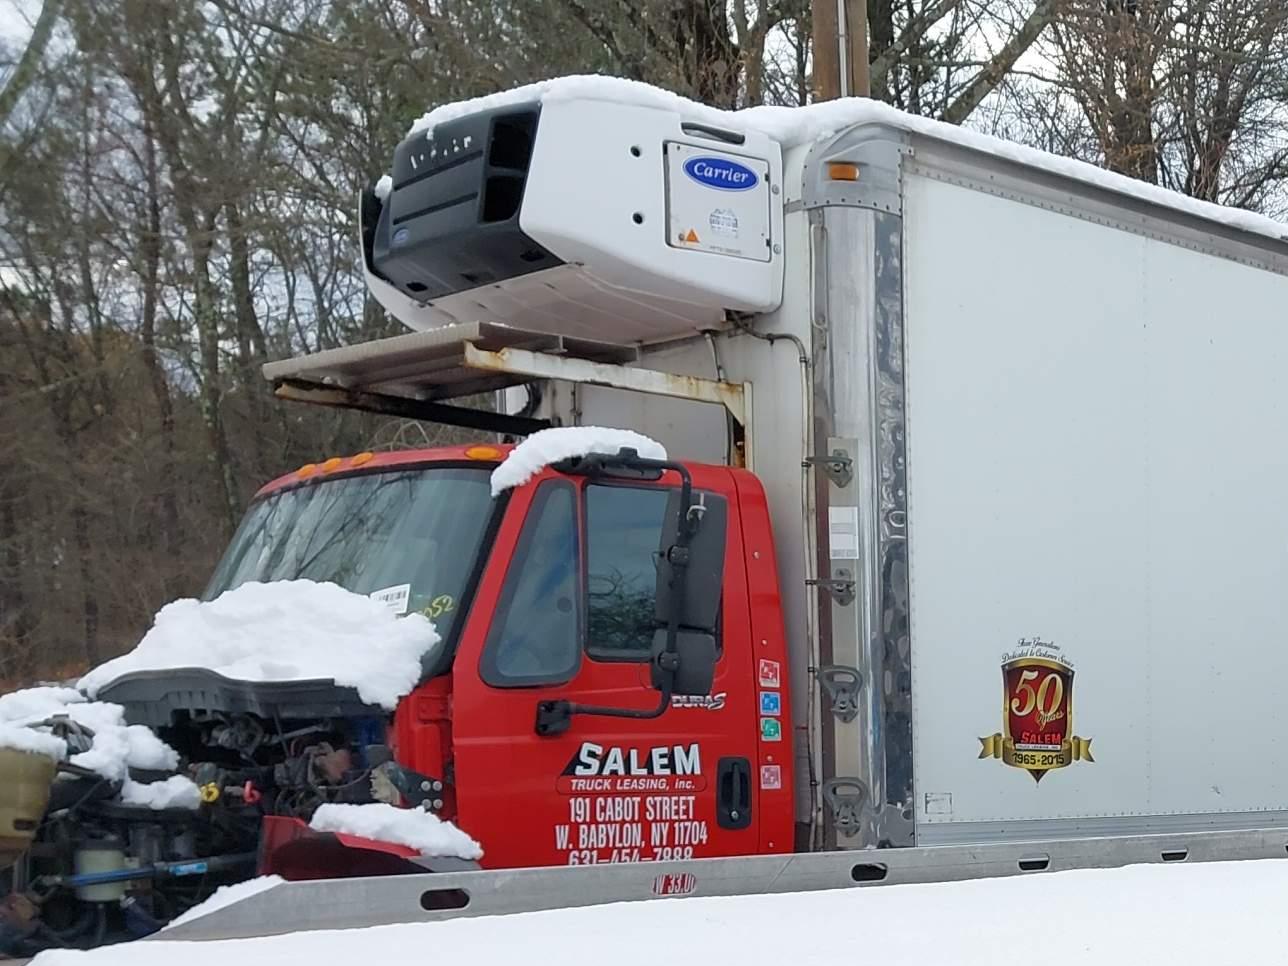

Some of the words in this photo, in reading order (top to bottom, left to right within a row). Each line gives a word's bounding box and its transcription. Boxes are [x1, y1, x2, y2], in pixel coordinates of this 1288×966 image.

[693, 161, 749, 183] Carrier
[1011, 669, 1064, 717] 50
[1021, 731, 1062, 744] SALEM
[574, 742, 701, 776] SALEM
[570, 779, 612, 791] TRUCK
[616, 778, 670, 791] LEASING,
[675, 778, 696, 790] inc.
[569, 797, 591, 823] 191
[595, 796, 641, 822] CABOT
[645, 795, 696, 821] STREET
[555, 825, 574, 850] W.
[578, 823, 646, 849] BABYLON,
[650, 822, 670, 847] NY
[673, 821, 709, 846] 11704
